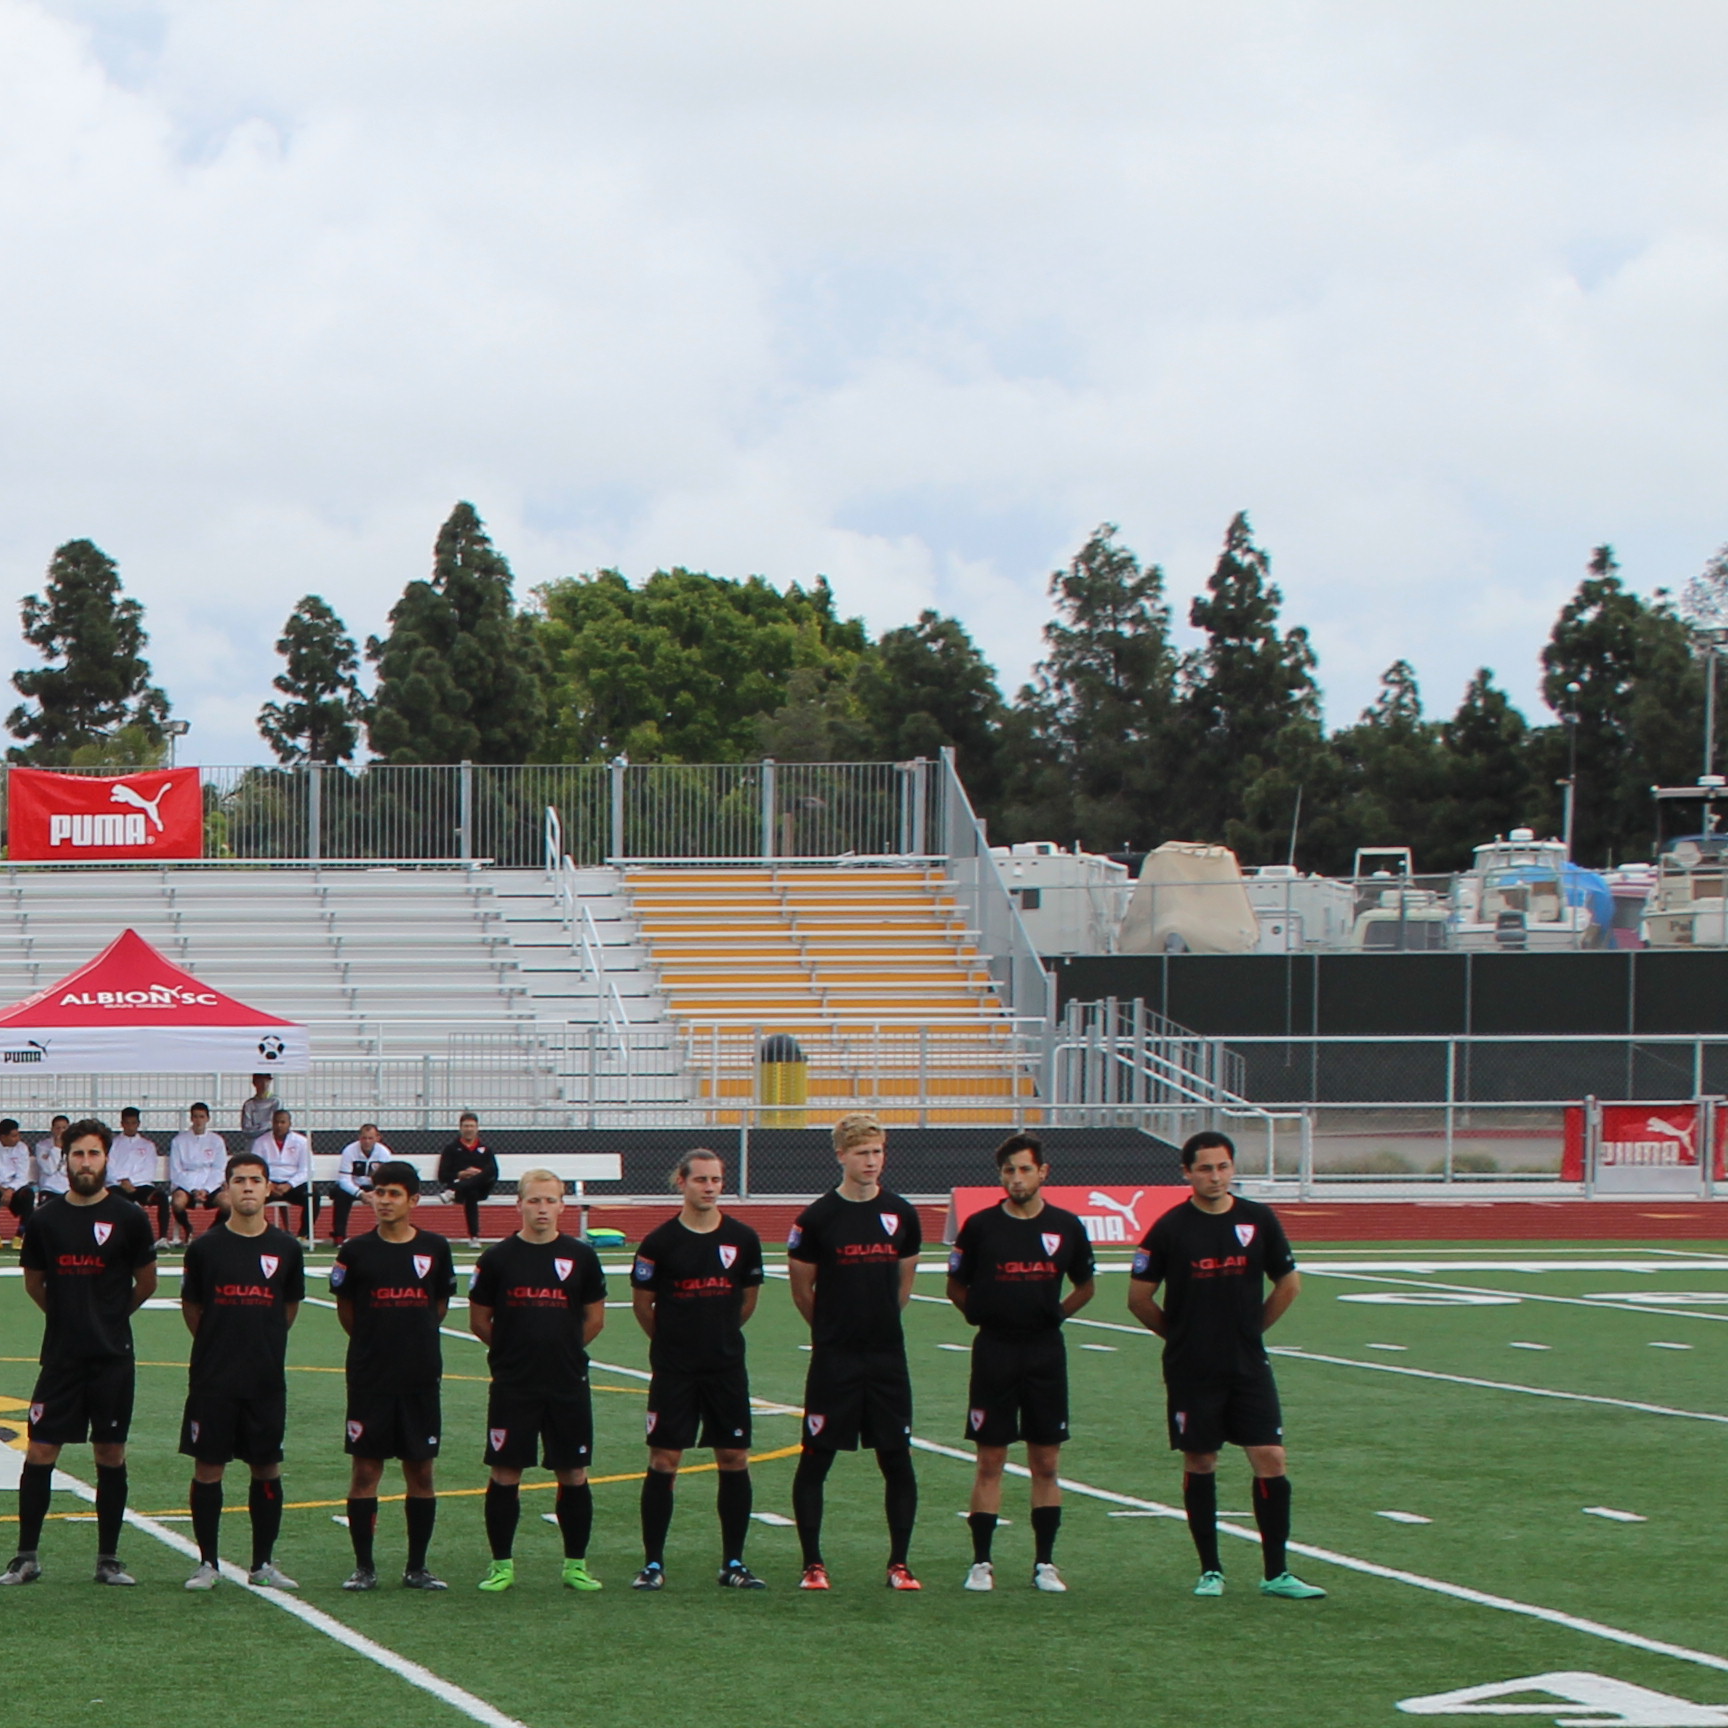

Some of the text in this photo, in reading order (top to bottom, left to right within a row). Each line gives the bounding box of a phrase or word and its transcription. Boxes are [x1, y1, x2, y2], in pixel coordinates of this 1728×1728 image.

[50, 814, 145, 846] PUMA
[60, 992, 173, 1005] ALBION
[181, 993, 218, 1005] SC
[4, 1051, 41, 1063] PUMA
[1078, 1215, 1126, 1242] MA
[377, 1287, 428, 1299] QUAIL
[514, 1286, 568, 1300] QUAIL
